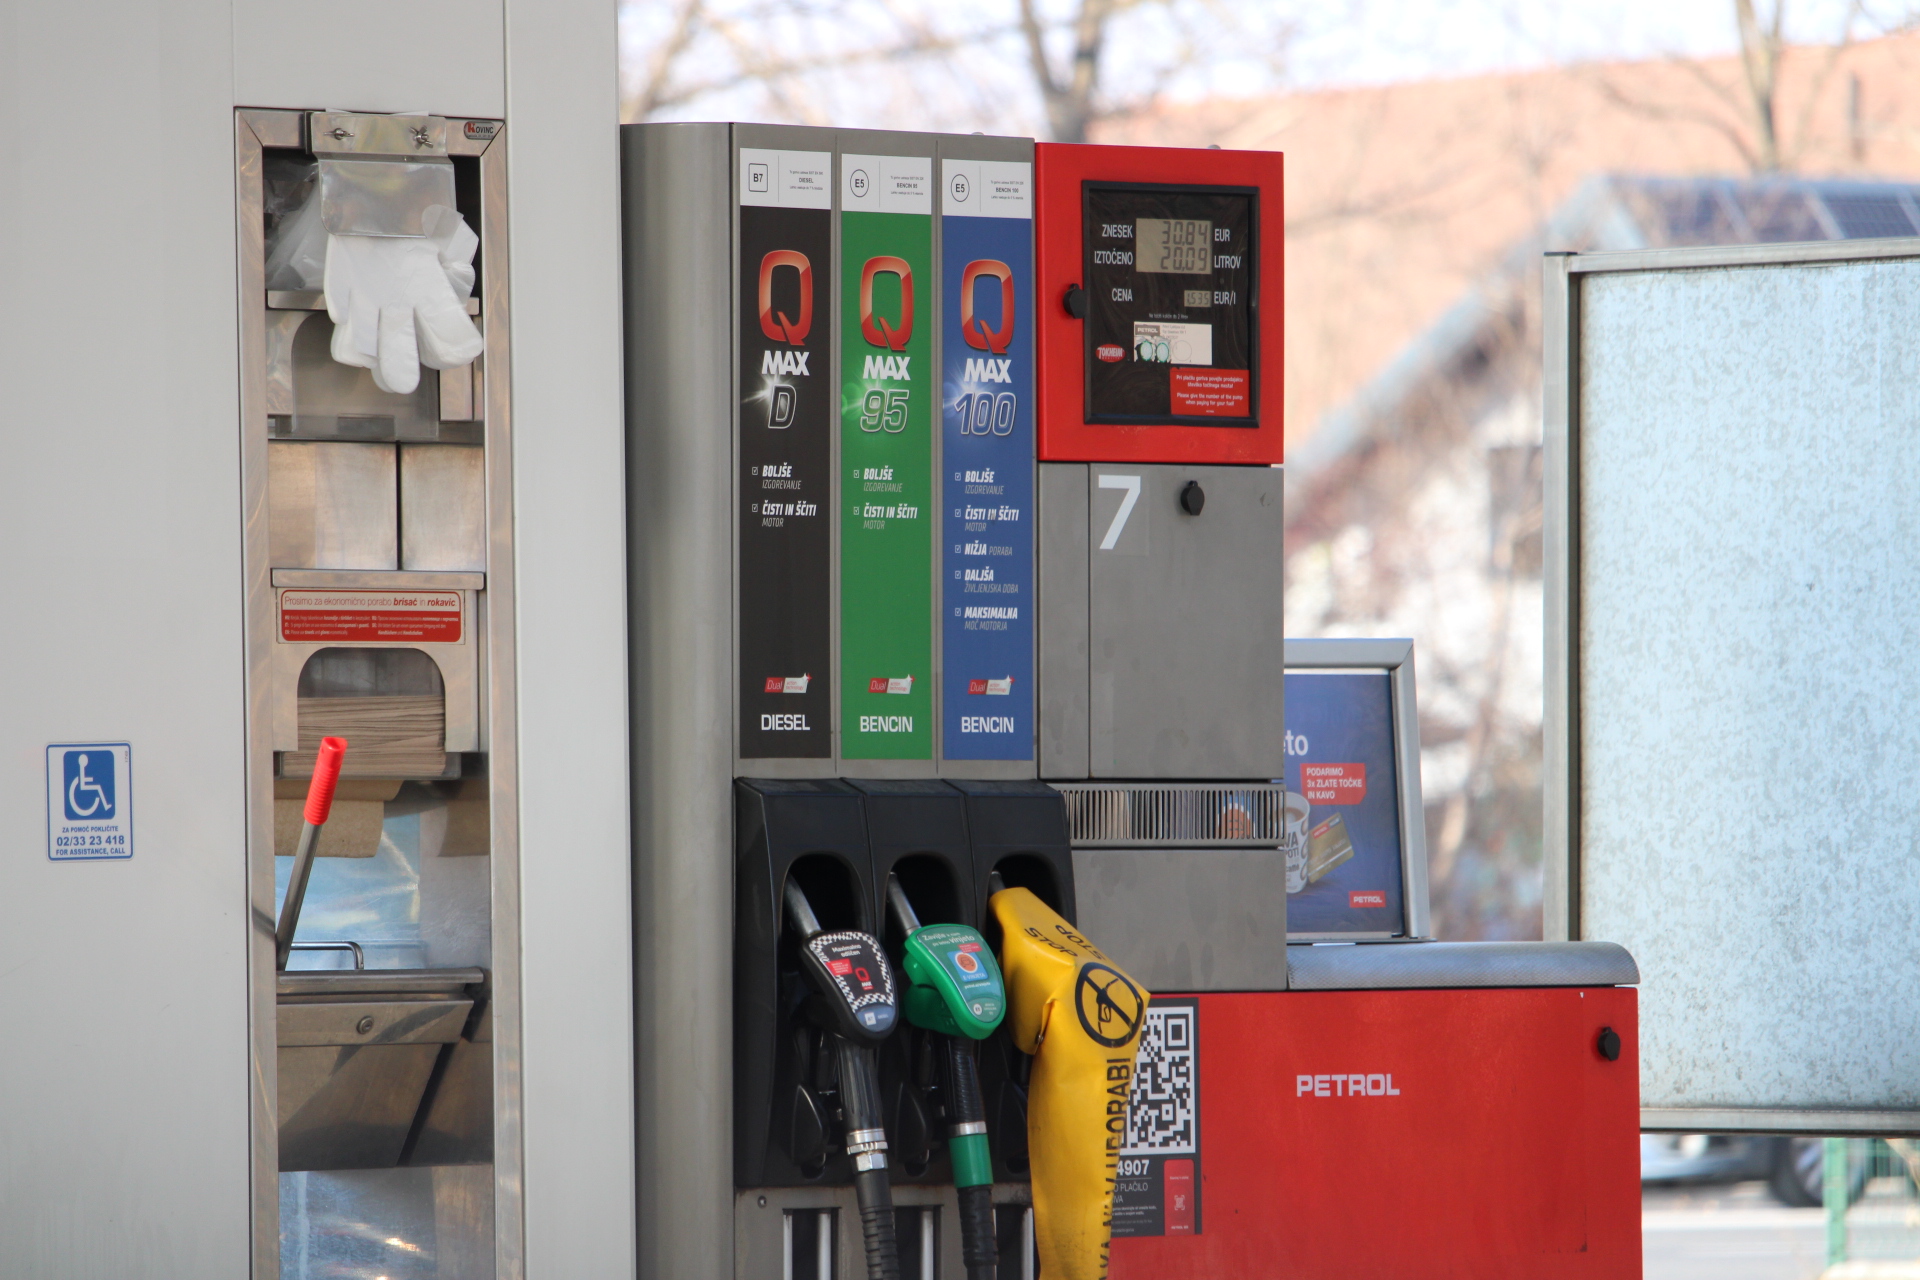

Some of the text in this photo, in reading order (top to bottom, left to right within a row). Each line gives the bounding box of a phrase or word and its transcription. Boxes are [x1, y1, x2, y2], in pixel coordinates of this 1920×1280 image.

[467, 122, 494, 134] KOVINC
[753, 173, 764, 182] B7
[854, 179, 864, 188] E5
[955, 184, 965, 193] E5
[1102, 224, 1133, 238] ZNESEK
[1214, 229, 1230, 242] EUR
[1094, 248, 1133, 265] IZTOČENO
[1214, 255, 1241, 269] LITROV
[758, 249, 814, 346] Q
[1112, 288, 1133, 301] CENA
[860, 256, 914, 351] Q
[961, 258, 1014, 354] Q
[762, 350, 810, 376] MAX
[862, 355, 911, 380] MAX
[964, 358, 1012, 384] MAX
[768, 384, 797, 429] D
[860, 388, 910, 433] 95
[954, 392, 1016, 436] 100
[762, 462, 792, 478] BOLJŠE
[863, 465, 893, 481] BOLJŠE
[965, 468, 995, 483] BOLJŠE
[762, 479, 802, 490] IZGOREVANJE
[863, 482, 903, 493] IZGOREVANJE
[965, 484, 1004, 495] IZGOREVANJE
[762, 500, 817, 516] ČISTI IN ŠČITI
[863, 502, 918, 519] ČISTI IN ŠČITI
[965, 505, 1019, 521] ČISTI IN ŠČITI
[1098, 474, 1141, 550] 7
[762, 518, 784, 528] MOTOR
[863, 520, 885, 530] MOTOR
[965, 522, 986, 532] MOTOR
[964, 540, 1012, 556] NIŽJA PORABA
[964, 566, 994, 581] DALJŠA
[964, 581, 1019, 594] ŽIVLJENJSKA DOBA
[284, 596, 312, 606] Prosimo
[324, 597, 365, 606] ekonomično
[368, 598, 392, 607] porabo
[394, 597, 418, 606] brisač
[427, 598, 456, 606] rokavic
[964, 606, 1018, 620] MAKSIMALNA
[964, 619, 1007, 631] MOČ MOTORJA
[767, 679, 783, 690] Dual
[870, 680, 886, 690] Dual
[970, 682, 986, 692] Dual
[761, 714, 811, 731] DIESEL
[860, 716, 913, 732] BENCIN
[961, 716, 1014, 733] BENCIN
[1284, 730, 1308, 756] to
[1306, 767, 1343, 776] PODARIMO
[1307, 777, 1362, 788] 3x ZLATE TOČKE
[1308, 791, 1335, 799] IN KAVO
[56, 835, 125, 846] 02/33 23 418
[1353, 895, 1382, 903] PETROL
[1024, 927, 1078, 957] STOP
[1055, 924, 1106, 961] STOP
[855, 967, 870, 982] Q
[1297, 1073, 1400, 1097] PETROL
[1117, 1159, 1150, 1176] 4907
[1120, 1181, 1148, 1192] PLAČILO
